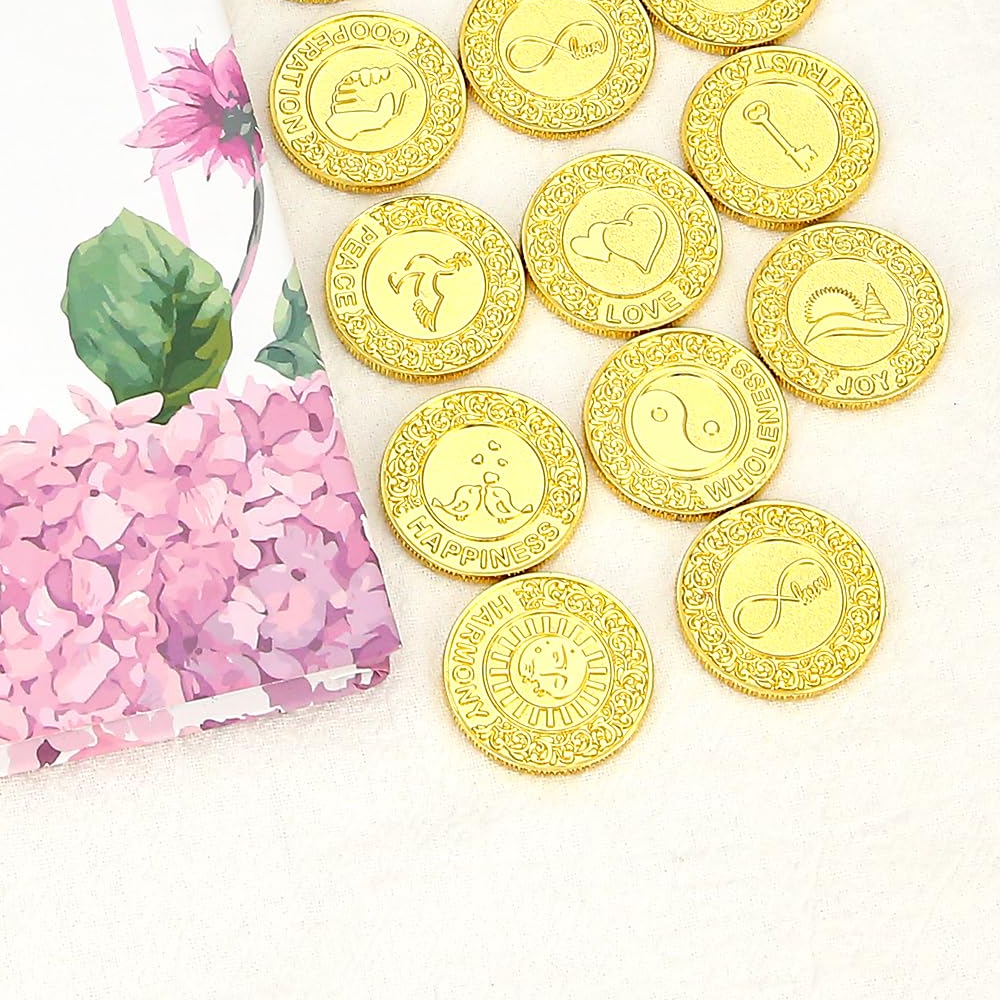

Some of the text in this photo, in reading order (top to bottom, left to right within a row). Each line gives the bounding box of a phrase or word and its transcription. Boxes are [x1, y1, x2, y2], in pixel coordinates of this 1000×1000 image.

[279, 20, 410, 134] COOPERATION
[754, 53, 841, 97] TRUST
[333, 222, 379, 308] PEACE
[605, 291, 682, 325] LOVE
[836, 369, 890, 396] JOY
[704, 359, 781, 502] WHOLENESS
[406, 514, 562, 571] HAPPINESS
[451, 594, 514, 719] HARMONY
